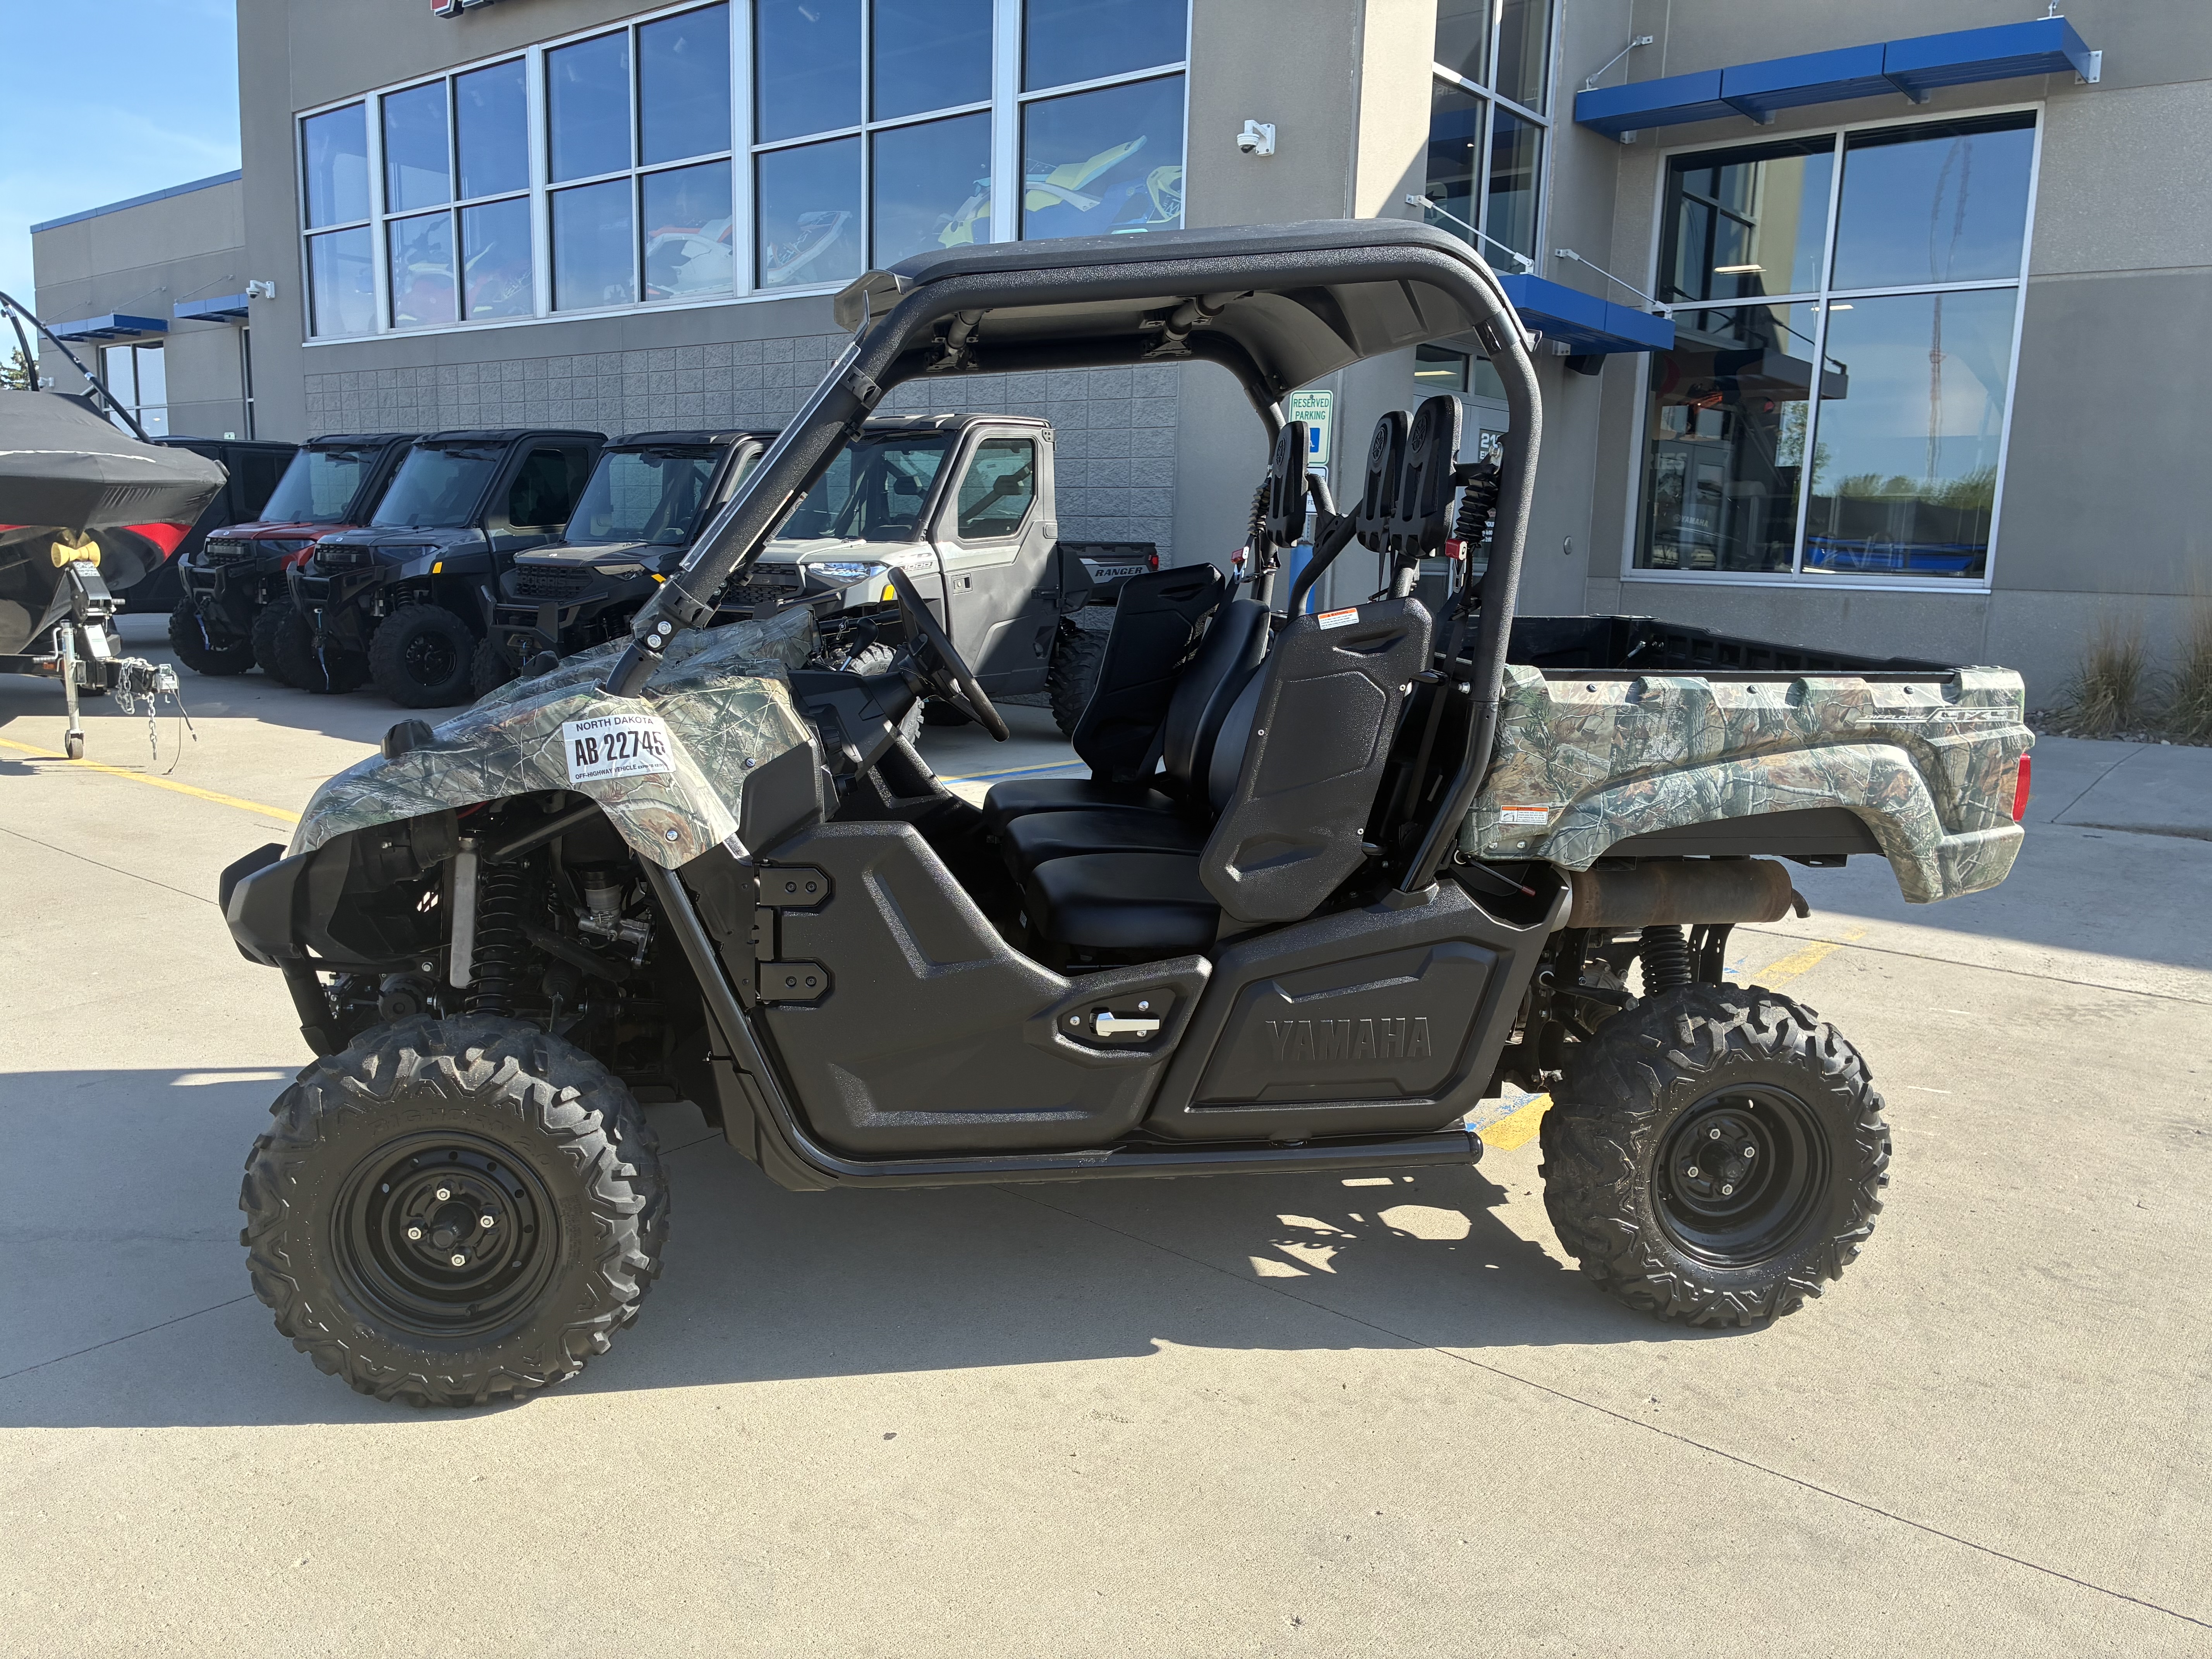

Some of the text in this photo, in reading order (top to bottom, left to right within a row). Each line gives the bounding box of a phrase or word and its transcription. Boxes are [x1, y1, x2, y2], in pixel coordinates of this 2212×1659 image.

[1293, 398, 1329, 407] RESERVED
[1295, 411, 1326, 420] PARKING
[1681, 515, 1709, 527] YAMAHA
[905, 562, 931, 570] 1000
[1095, 567, 1143, 577] RANGER
[521, 575, 566, 587] POLARIS
[576, 716, 654, 732] NORTH DAKOTA
[575, 731, 666, 767] AB 22745
[575, 767, 613, 780] OFF-HIGHWAY
[614, 764, 637, 773] VEHICLE
[1265, 1017, 1431, 1061] YAMAHA
[368, 1107, 554, 1165] BIGHORN 2.0
